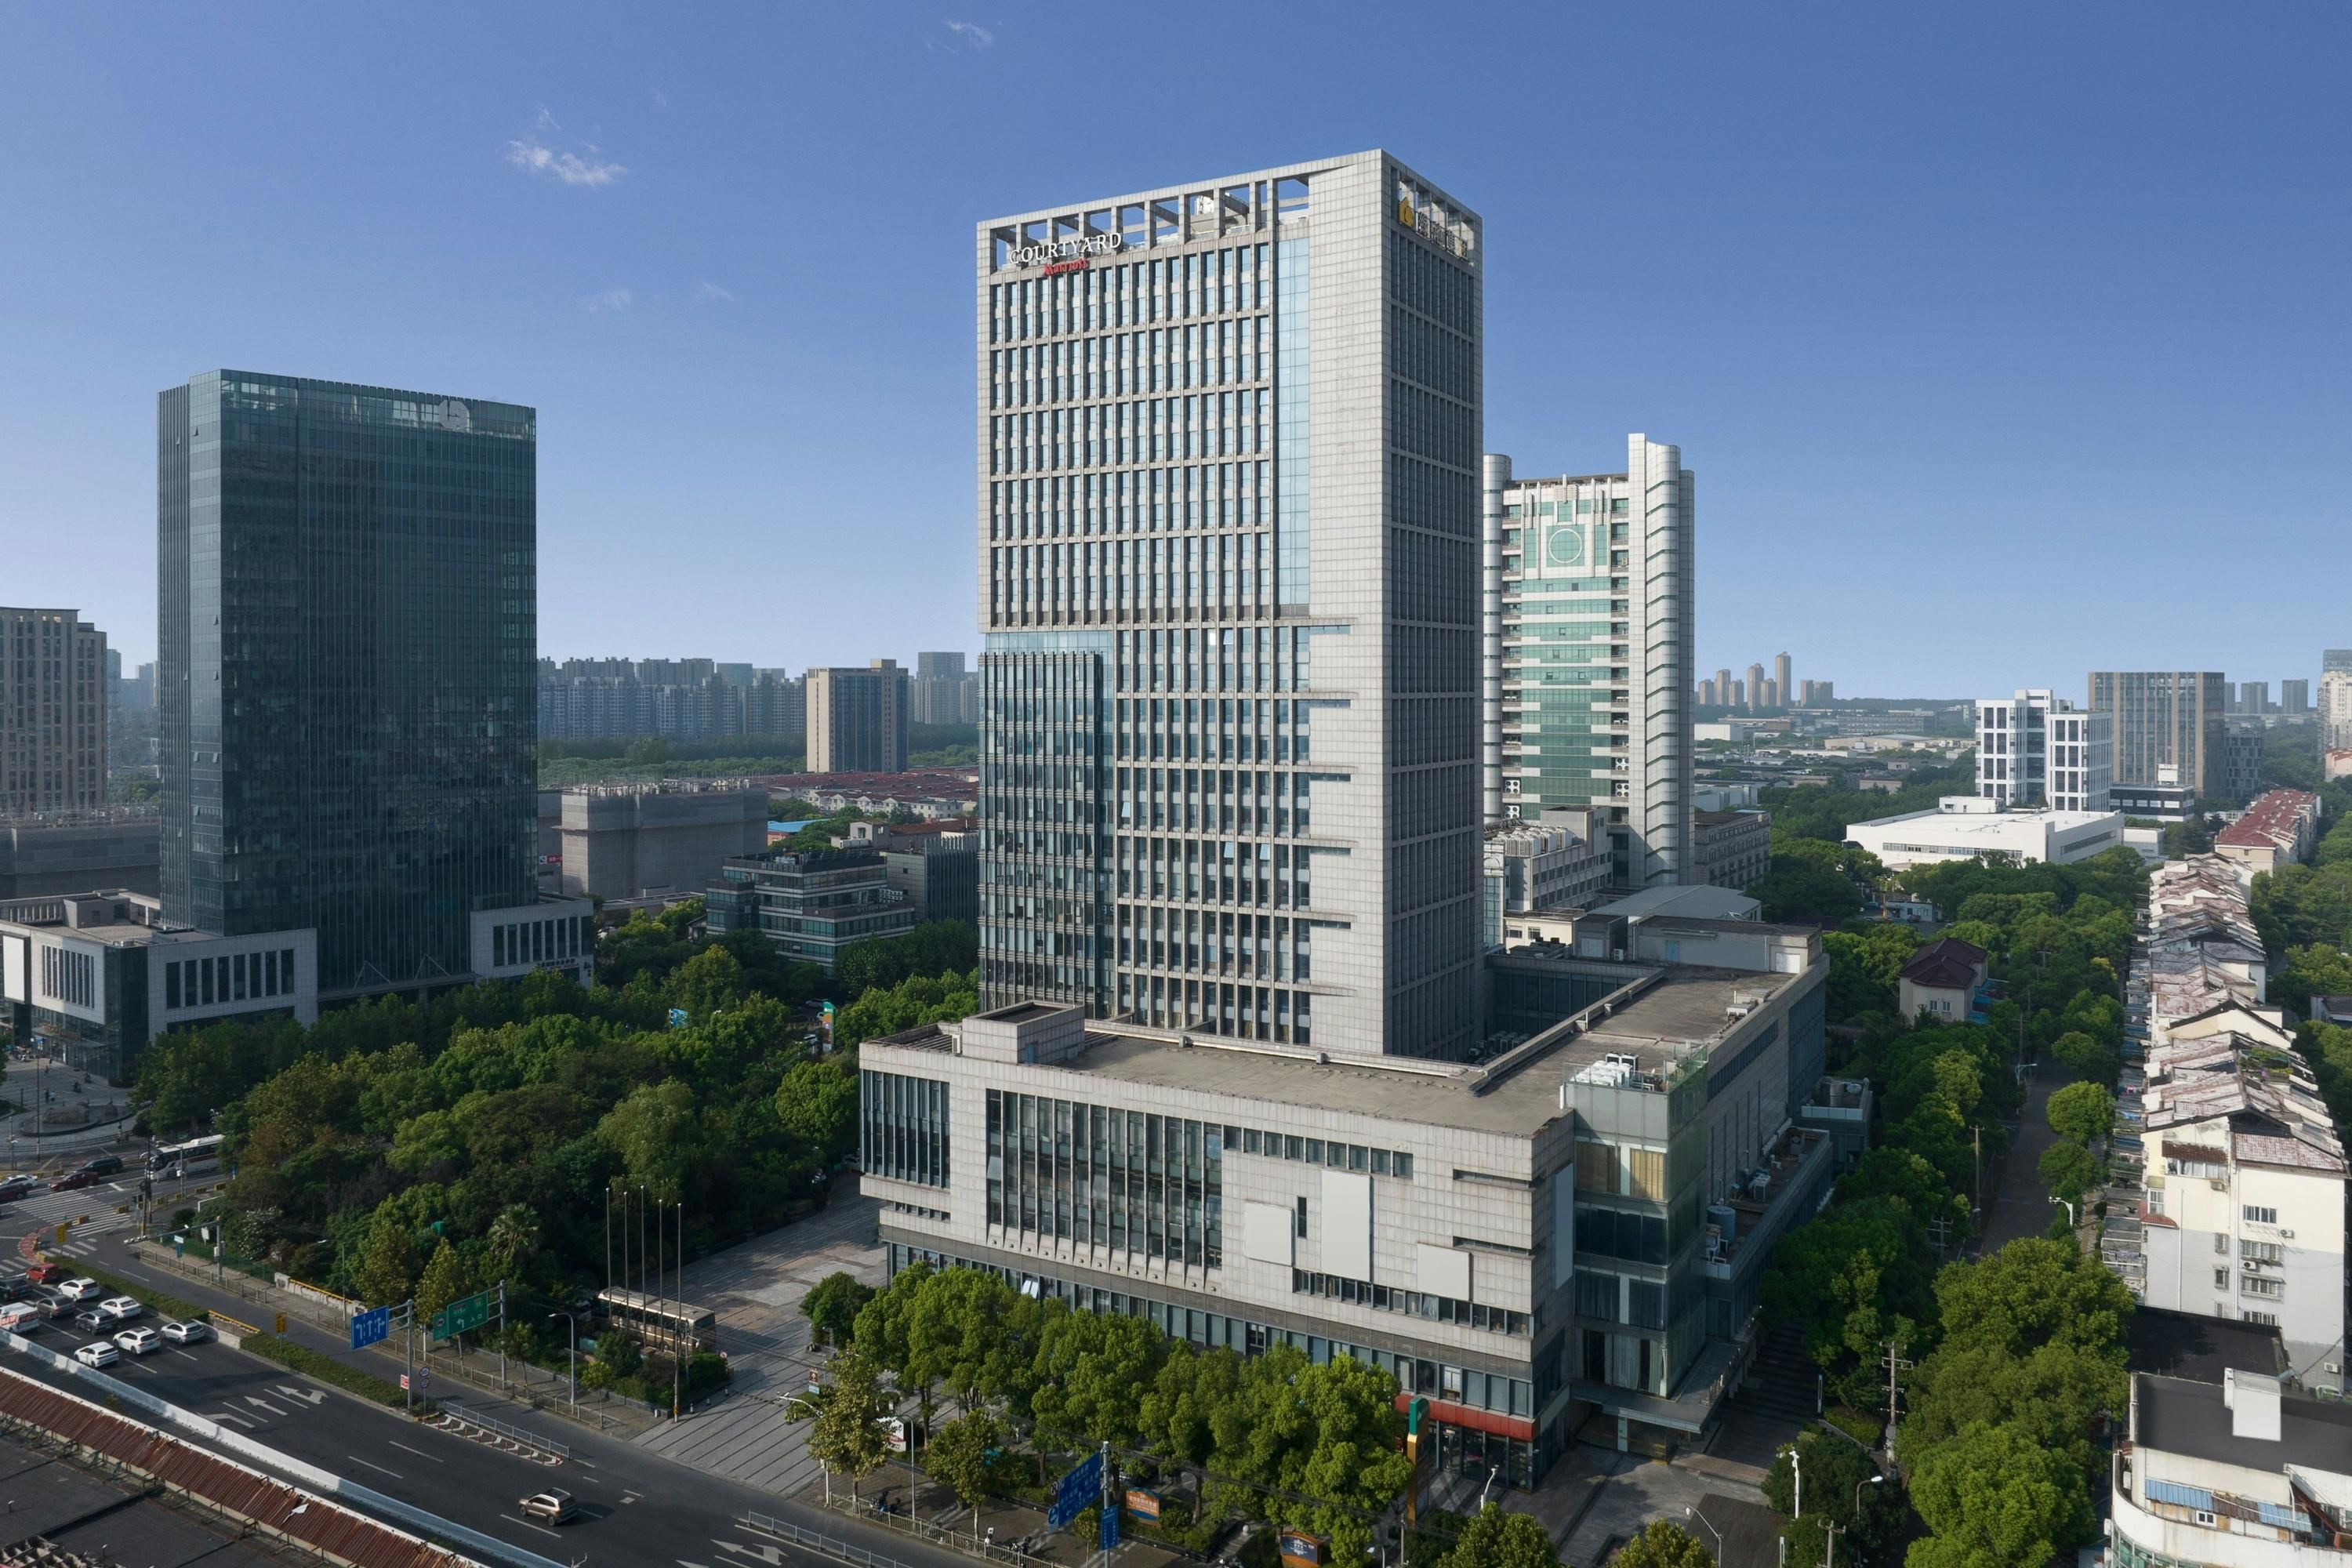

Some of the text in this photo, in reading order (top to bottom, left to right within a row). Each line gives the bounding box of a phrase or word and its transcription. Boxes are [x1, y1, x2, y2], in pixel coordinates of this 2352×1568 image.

[1010, 233, 1122, 264] COURTYARD
[1042, 257, 1089, 276] Marriott
[470, 1313, 482, 1323] 入口
